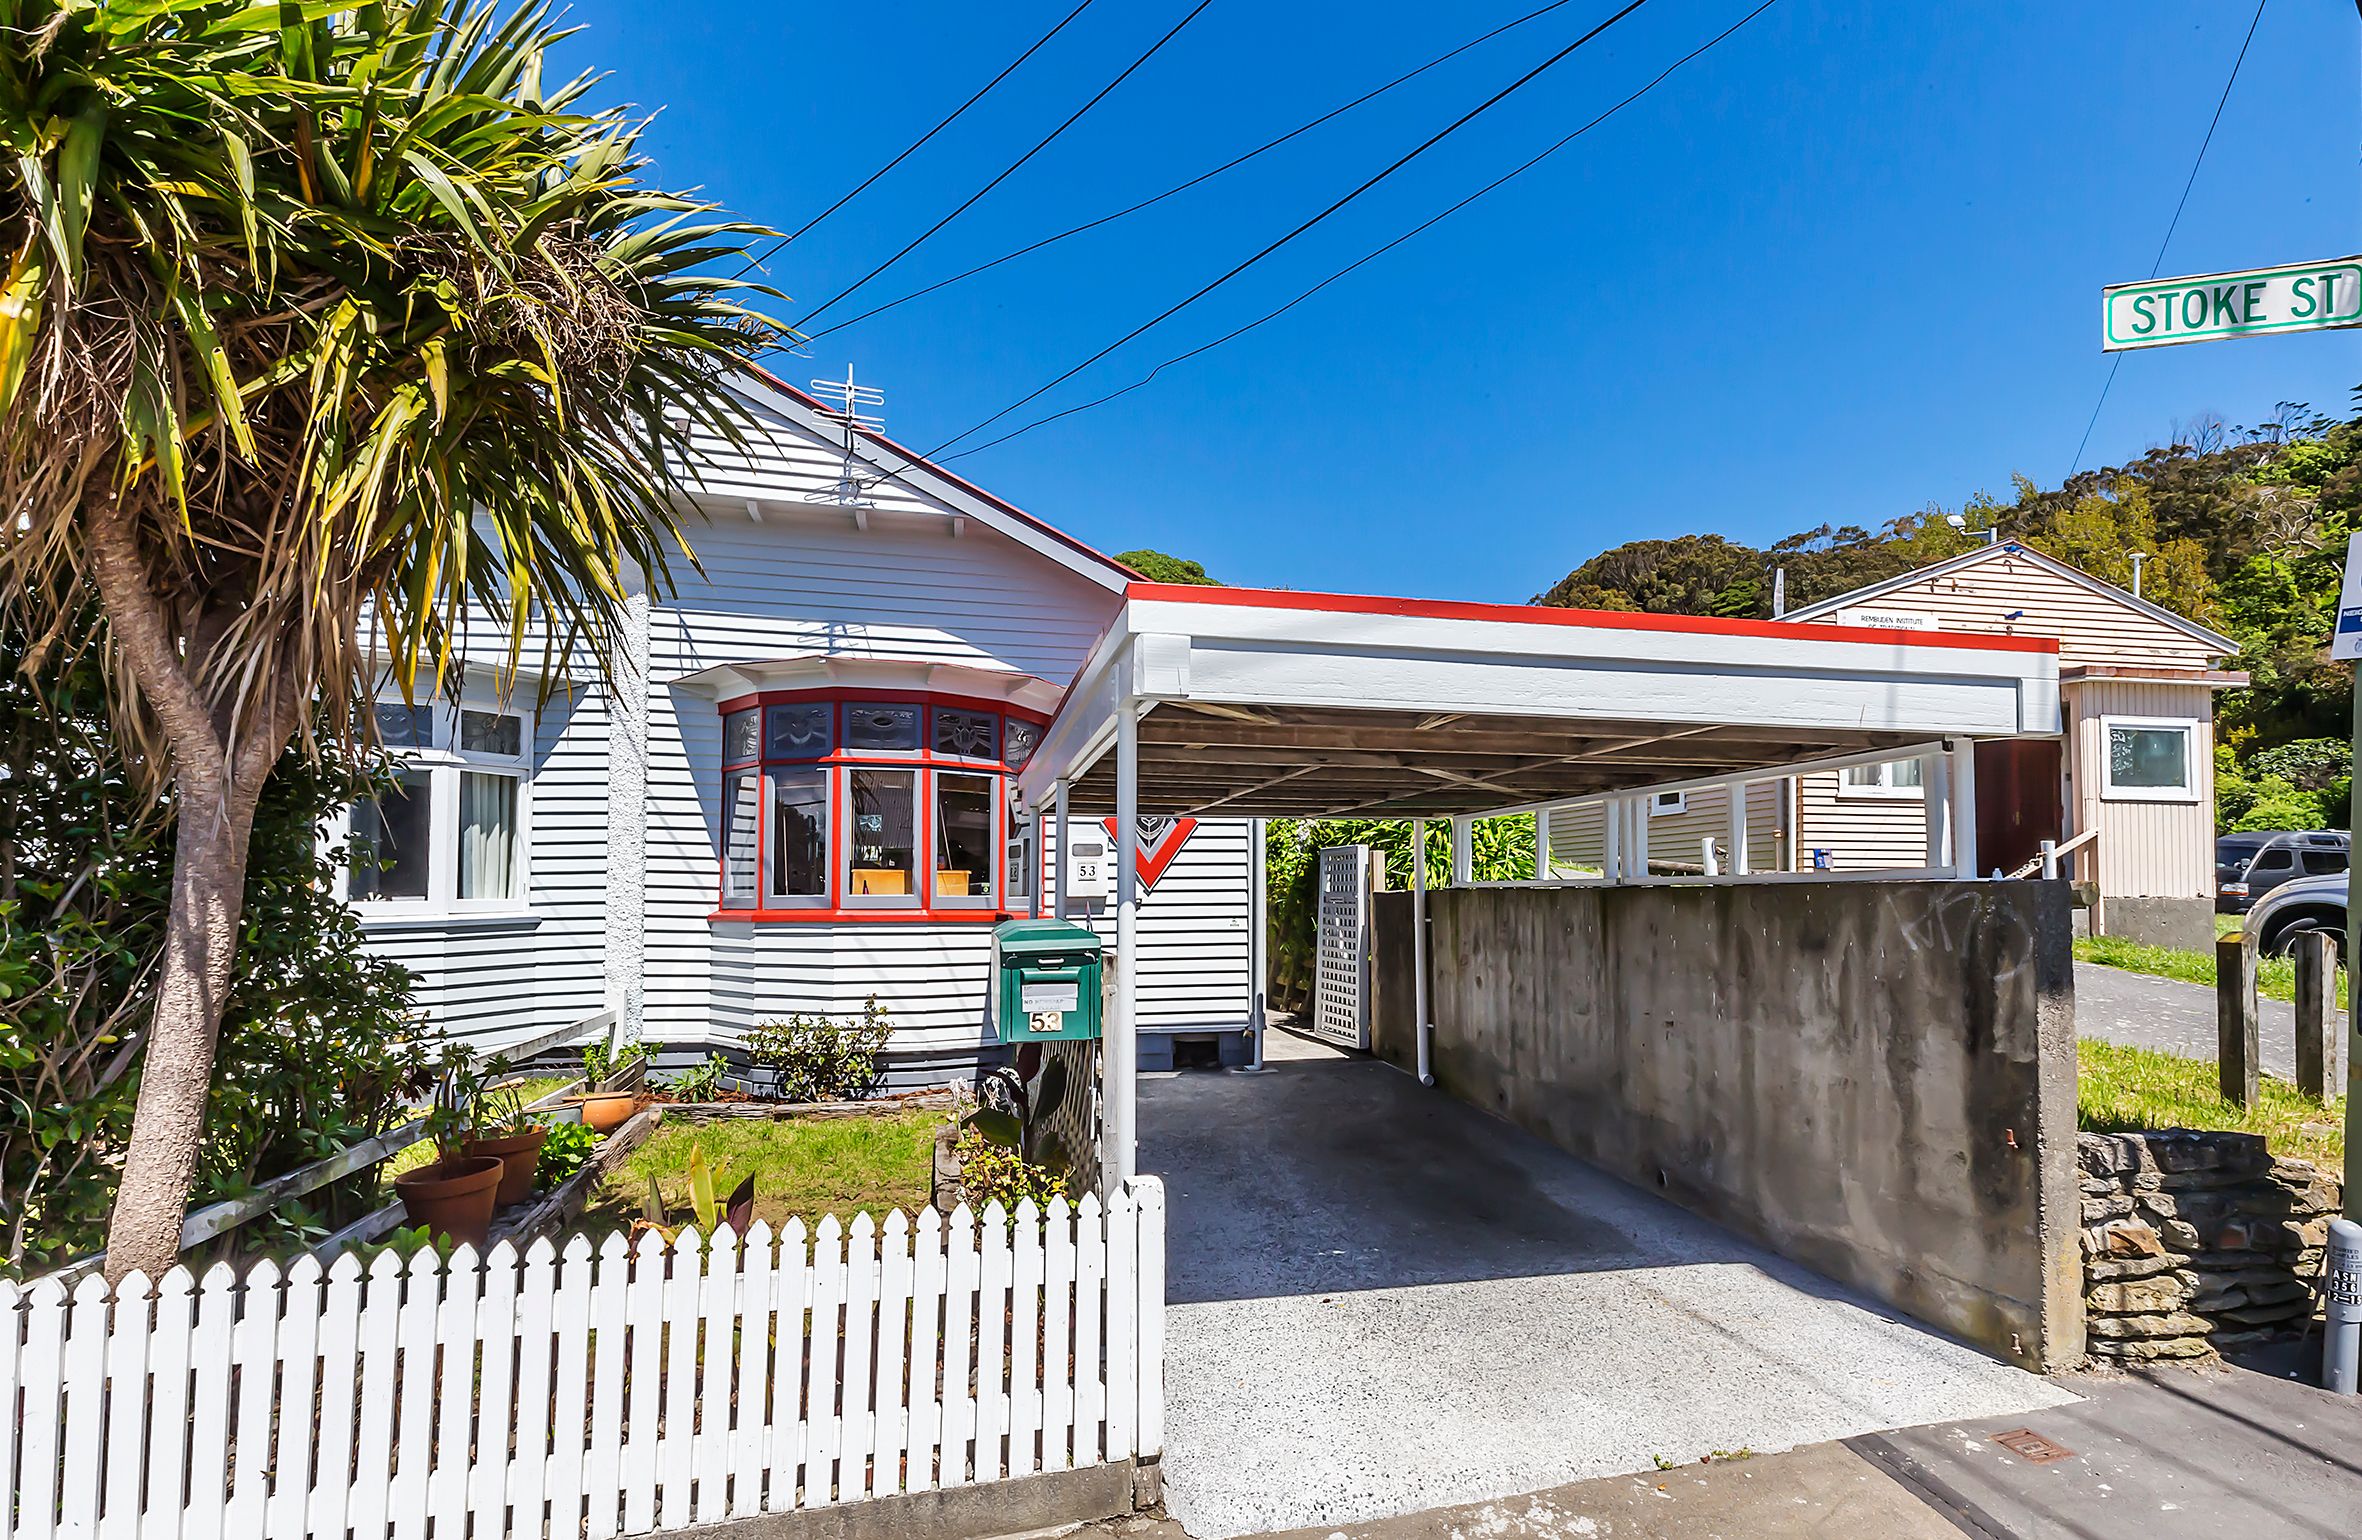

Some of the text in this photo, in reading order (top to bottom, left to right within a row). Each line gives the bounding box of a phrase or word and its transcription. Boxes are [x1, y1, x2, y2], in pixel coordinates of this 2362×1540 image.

[2131, 273, 2342, 334] STOKE ST
[1896, 617, 1923, 625] INSTITUTE
[1079, 865, 1096, 877] 53
[1031, 1012, 1060, 1031] 53
[2333, 1280, 2357, 1293] 356
